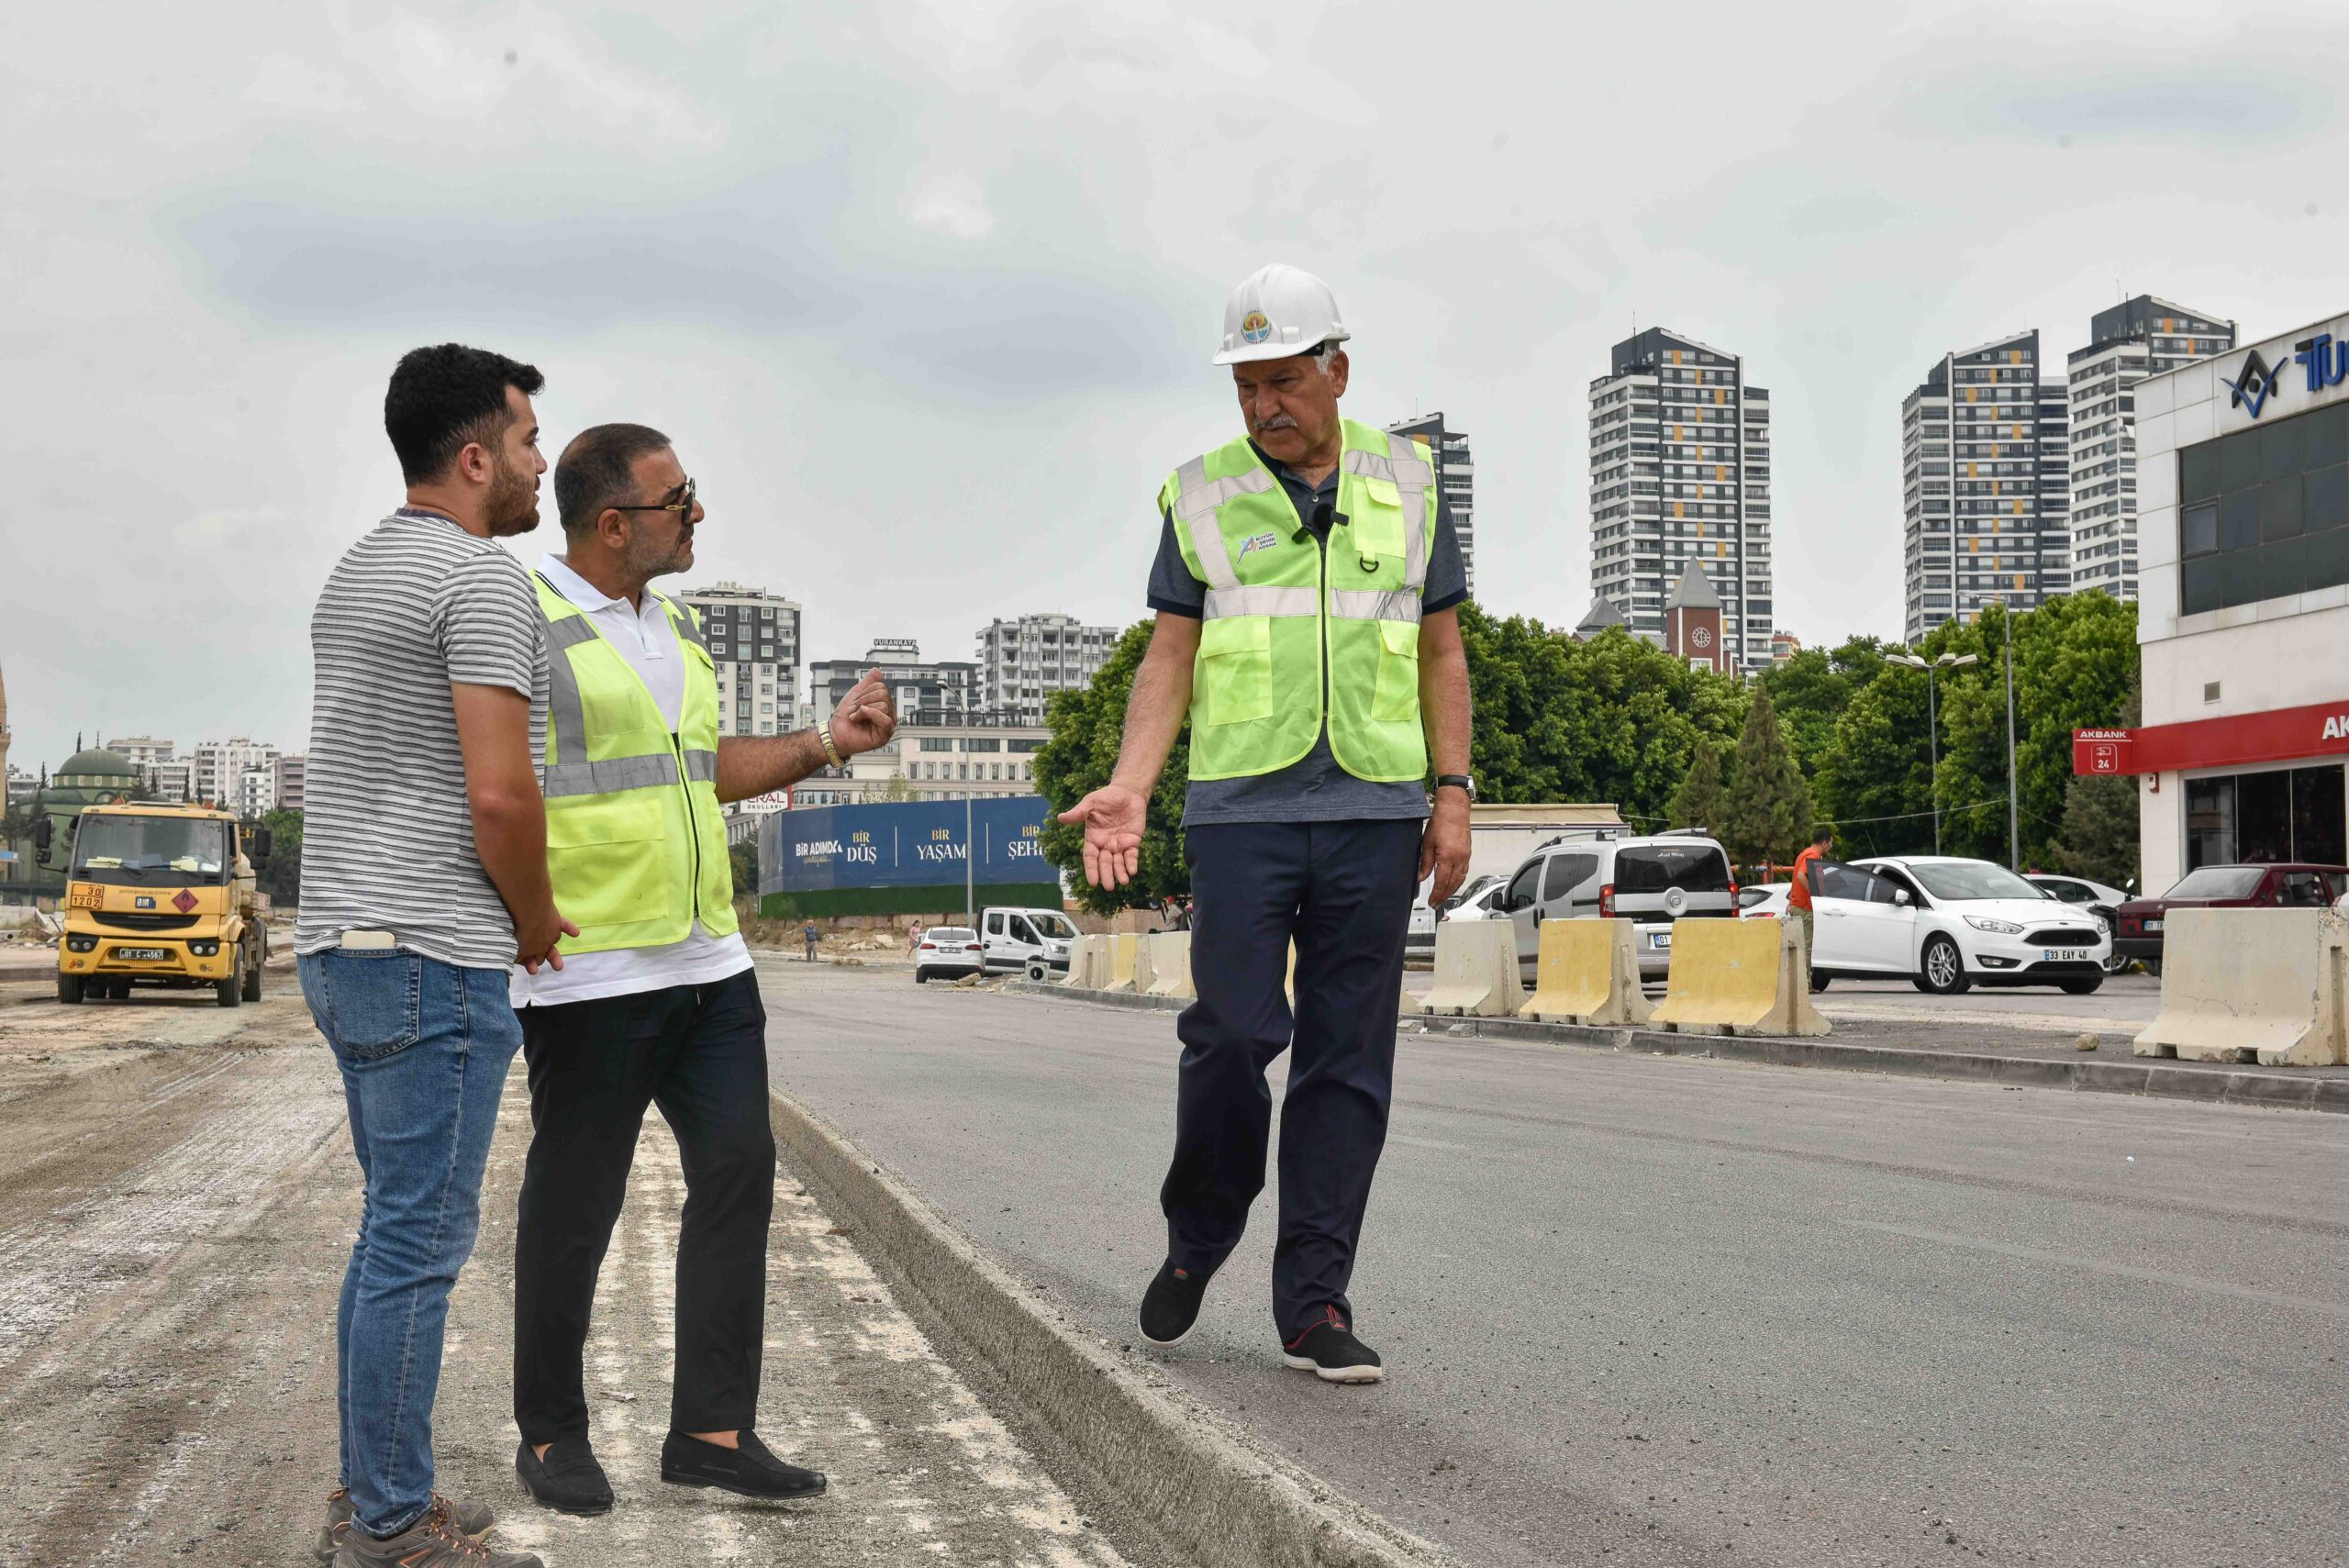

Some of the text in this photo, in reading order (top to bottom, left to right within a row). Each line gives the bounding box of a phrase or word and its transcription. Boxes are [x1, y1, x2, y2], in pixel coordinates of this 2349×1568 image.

[1258, 542, 1277, 550] ADANA
[874, 639, 917, 647] VURANKAYA
[2080, 730, 2127, 739] AKBANK
[2098, 759, 2110, 769] 24
[852, 830, 870, 843] BİR
[931, 828, 950, 840] BİR
[796, 841, 808, 857] BİR
[847, 843, 877, 864] DÜŞ
[917, 843, 967, 863] YAŞAM
[88, 886, 101, 896] 30
[73, 897, 99, 907] 1202
[1659, 936, 1668, 944] 01
[2049, 951, 2087, 960] 33 EAY 40
